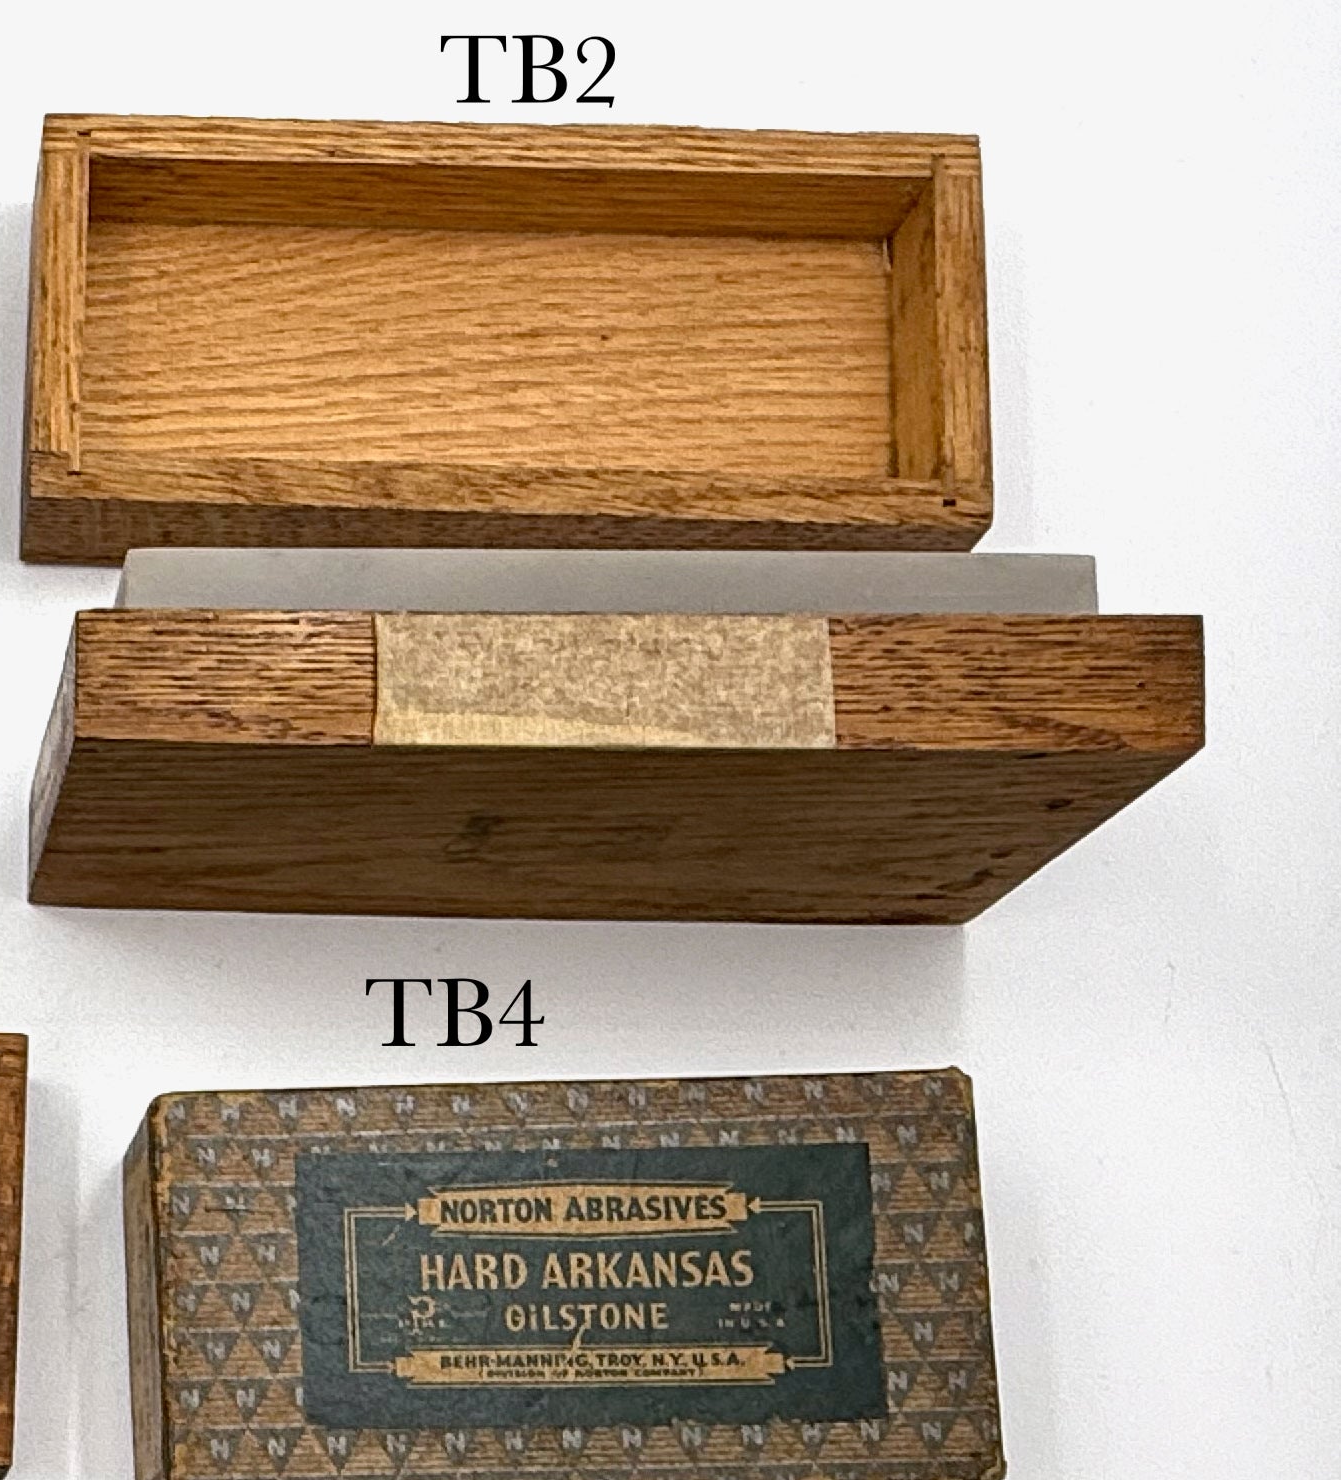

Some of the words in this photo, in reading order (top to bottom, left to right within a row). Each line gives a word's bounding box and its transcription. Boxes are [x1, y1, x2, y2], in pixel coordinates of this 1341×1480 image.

[440, 1197, 552, 1224] NORTON
[564, 1193, 728, 1222] ABRASIVES
[420, 1252, 528, 1291] HARD
[542, 1249, 754, 1289] ARKANSAS
[505, 1302, 670, 1331] OILSTONE
